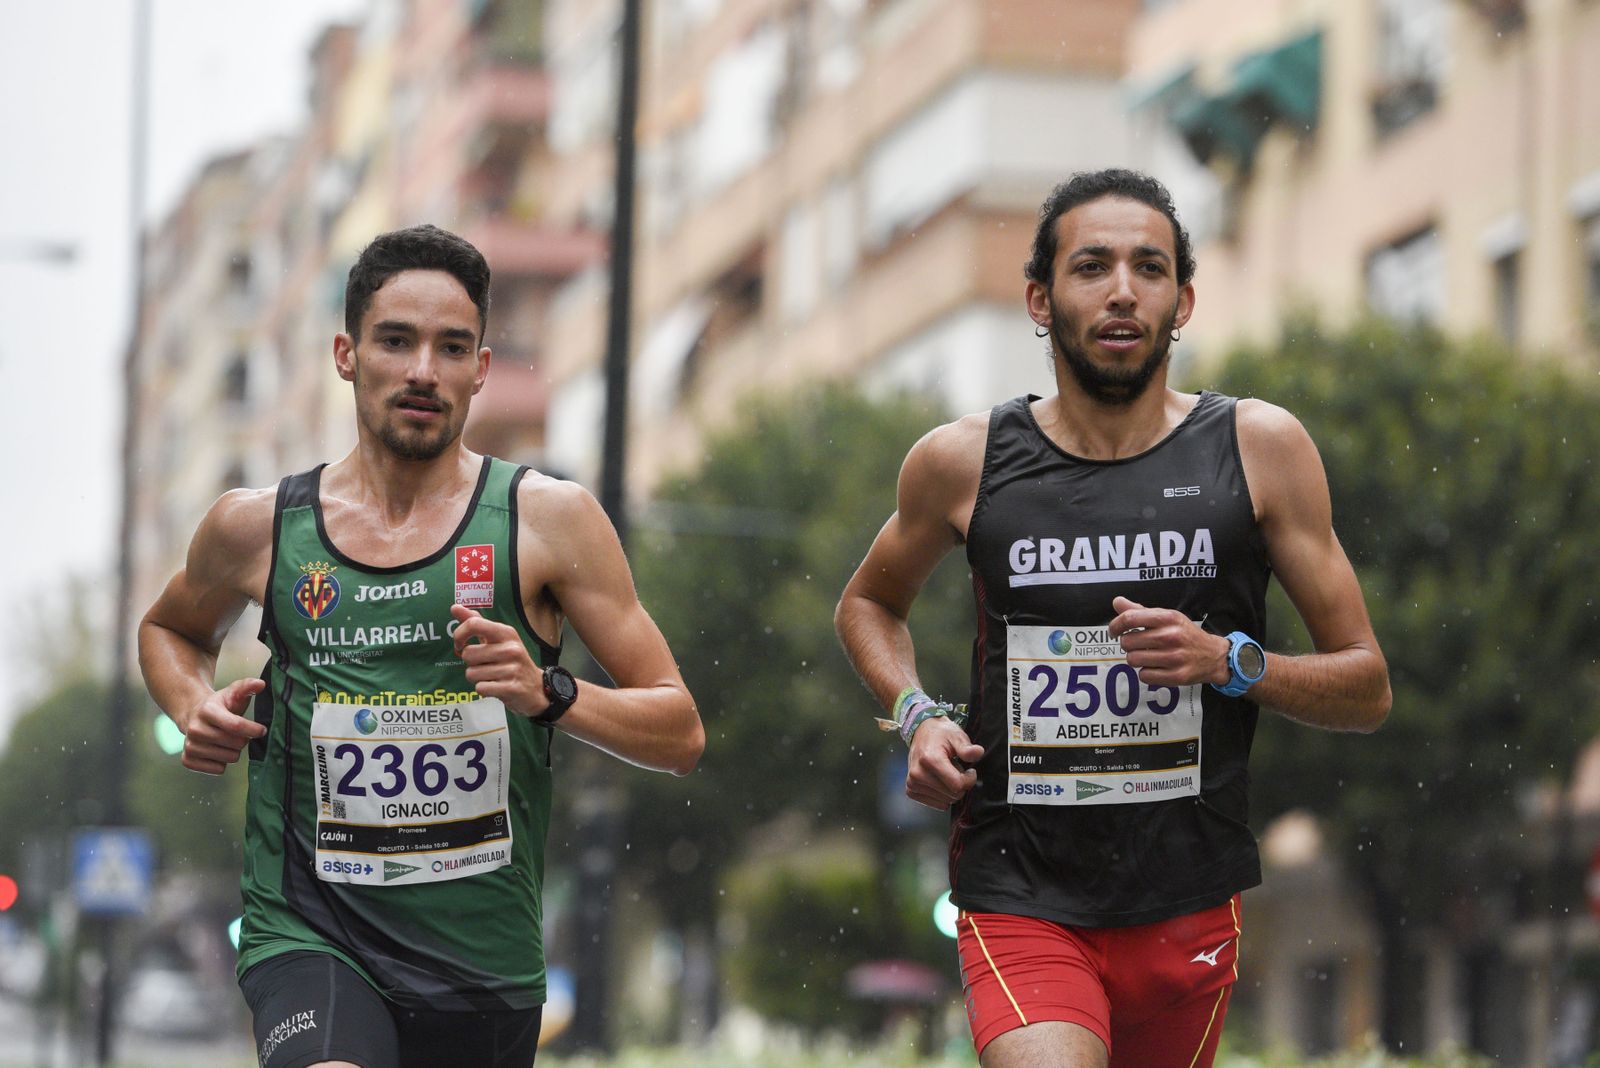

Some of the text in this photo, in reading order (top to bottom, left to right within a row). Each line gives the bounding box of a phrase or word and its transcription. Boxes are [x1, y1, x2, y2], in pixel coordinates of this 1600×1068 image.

[1009, 528, 1215, 574] GRANADA
[1139, 565, 1216, 580] RUN PROJECT
[305, 621, 441, 647] VILLARREAL
[337, 650, 384, 659] UNIVERSITAT
[1075, 646, 1116, 657] NIPPON
[1027, 664, 1180, 718] 2505
[381, 708, 463, 723] OXIMESA
[381, 724, 464, 736] NIPPON GASES
[1056, 721, 1159, 739] ABDELFATAH
[1013, 755, 1036, 765] CAJÓN
[334, 740, 488, 798] 2363
[382, 801, 449, 819] IGNACIO
[320, 831, 347, 842] CAJÓN
[377, 845, 405, 853] CIRCUITO
